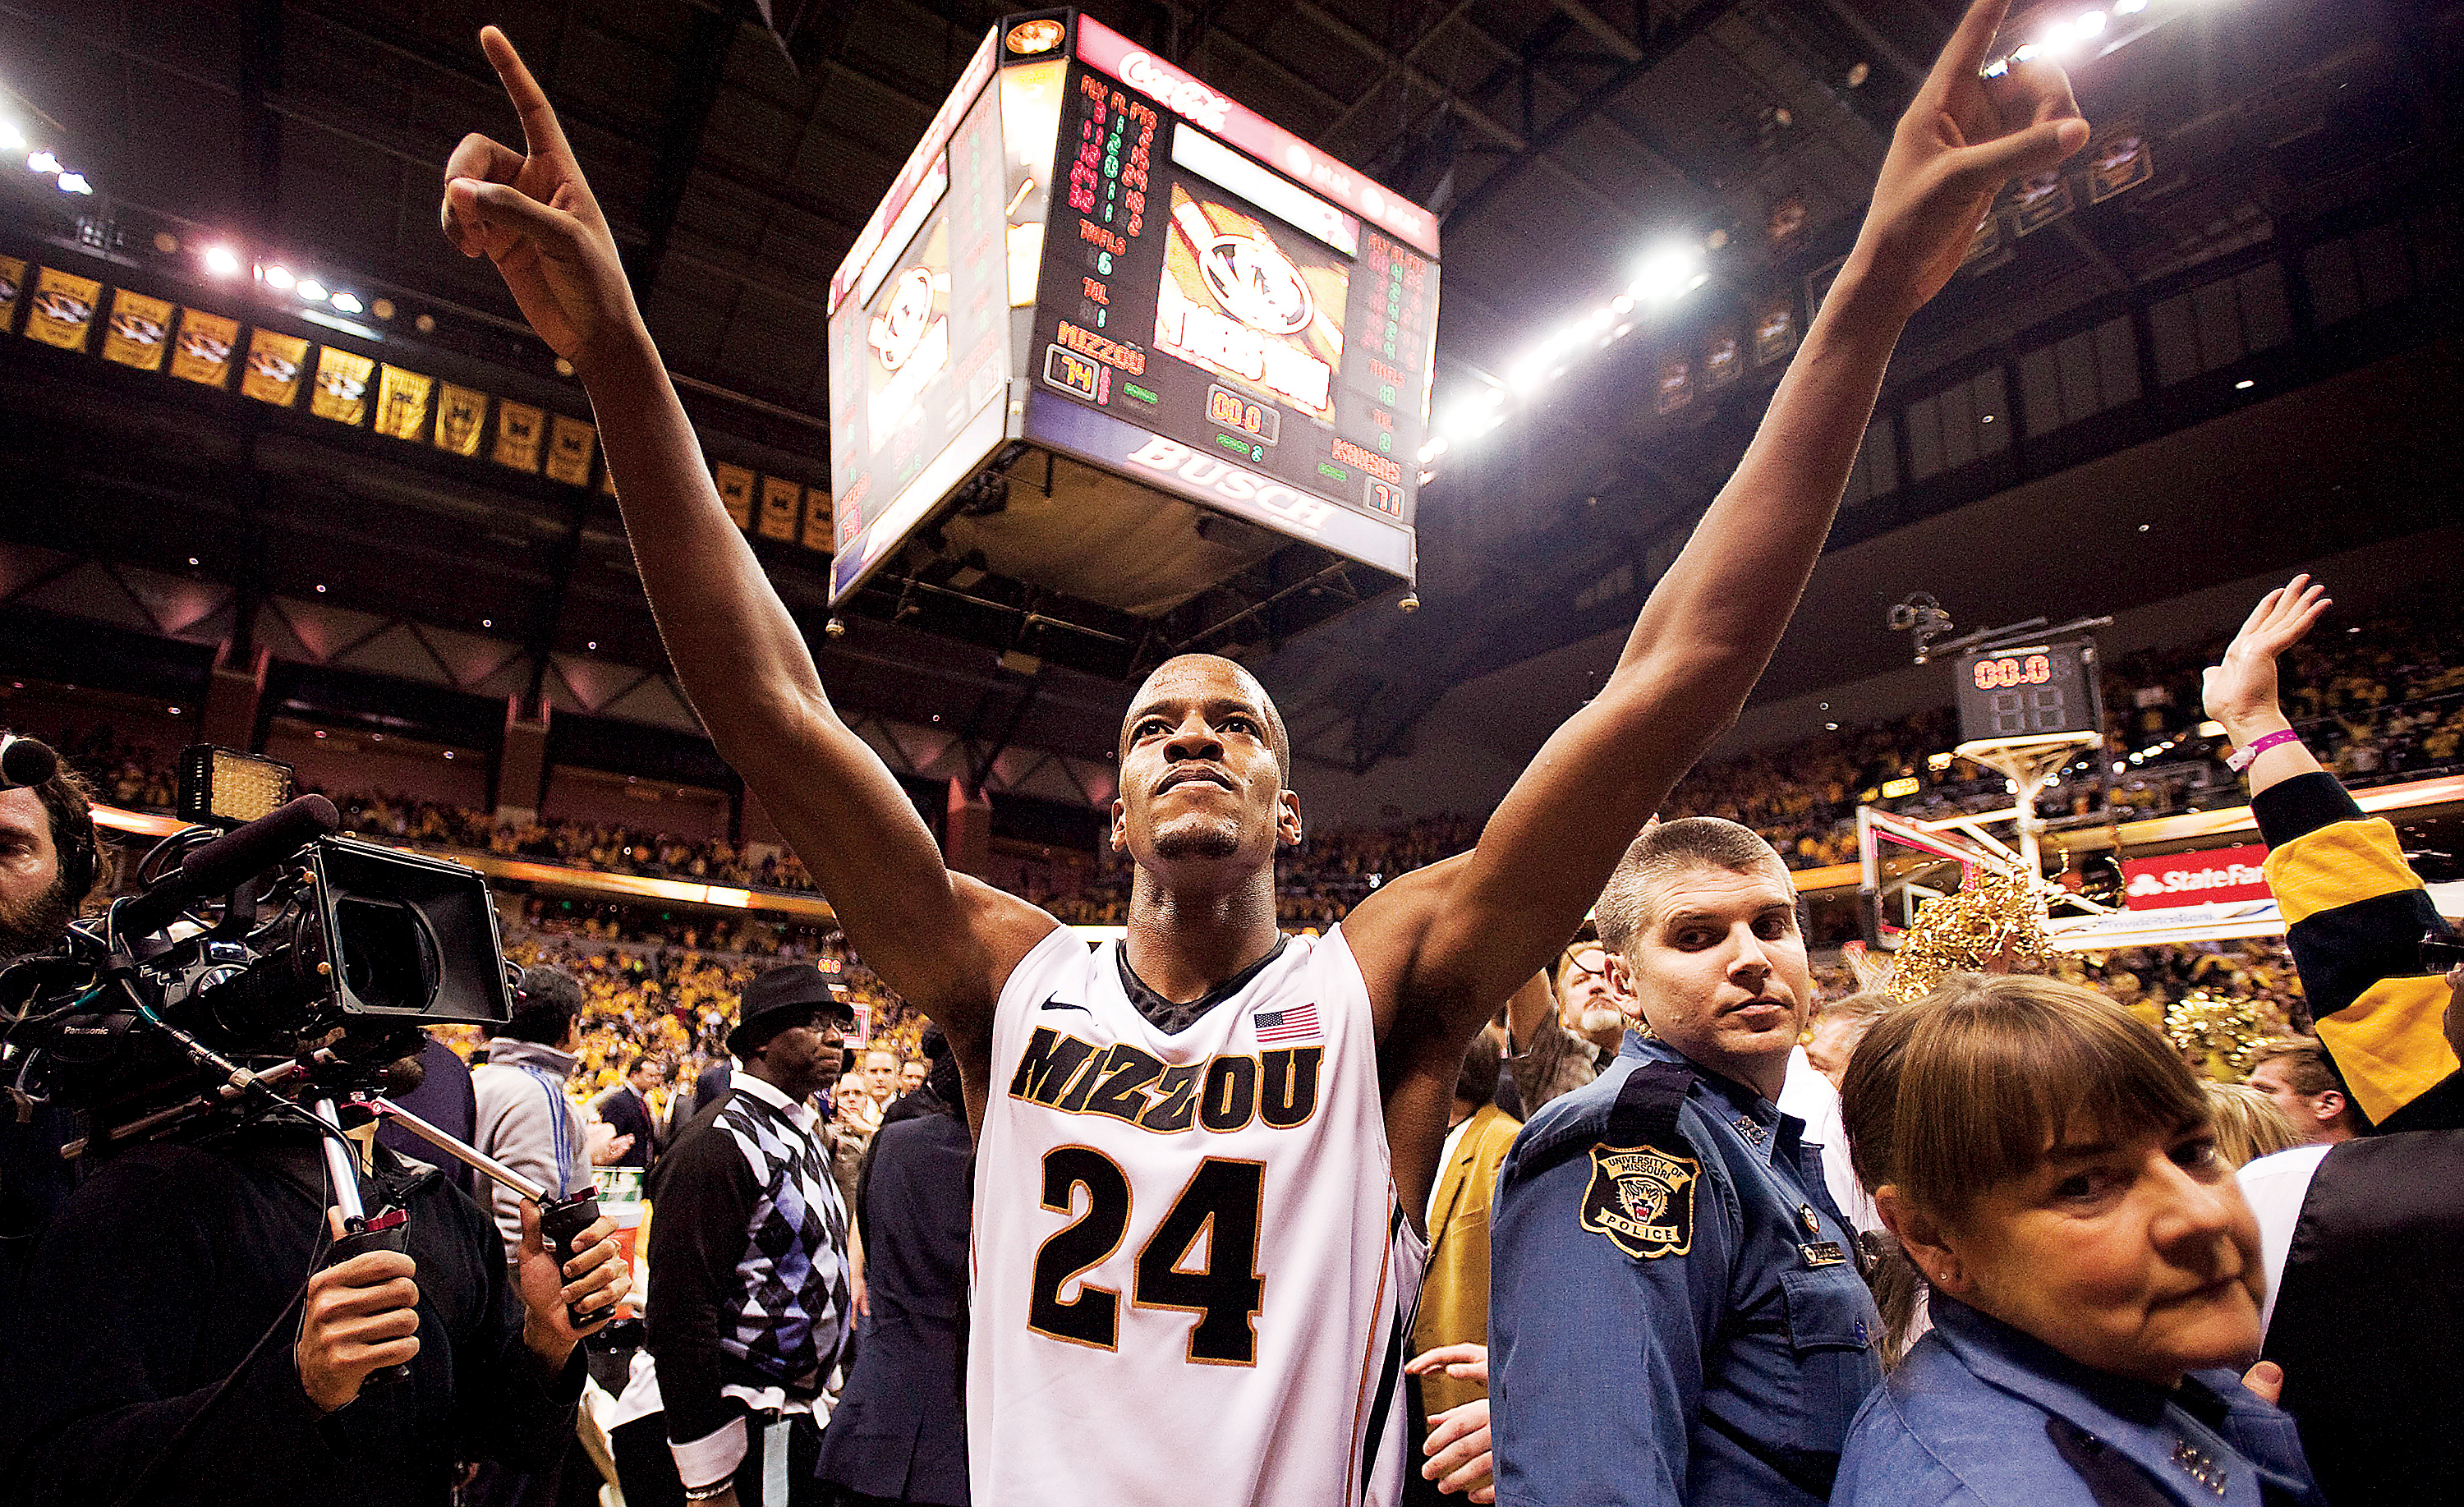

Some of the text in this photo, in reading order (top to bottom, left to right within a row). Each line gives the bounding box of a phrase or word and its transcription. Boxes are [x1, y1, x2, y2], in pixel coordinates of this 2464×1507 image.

[1097, 250, 1113, 276] 6
[1056, 319, 1147, 377] MIZZOU
[1060, 354, 1093, 392] 74
[1331, 437, 1401, 485] KANSAS
[1127, 434, 1339, 530] BUSCH
[1374, 484, 1401, 517] 71
[2162, 863, 2265, 893] StateFar
[64, 1026, 108, 1035] Panasonic
[1007, 1025, 1325, 1134] MIZZOU
[1607, 1156, 1685, 1178] UNIVERSITY OF
[1621, 1165, 1671, 1180] MISSOURI
[1607, 1216, 1672, 1240] POLICE
[1026, 1143, 1267, 1368] 24
